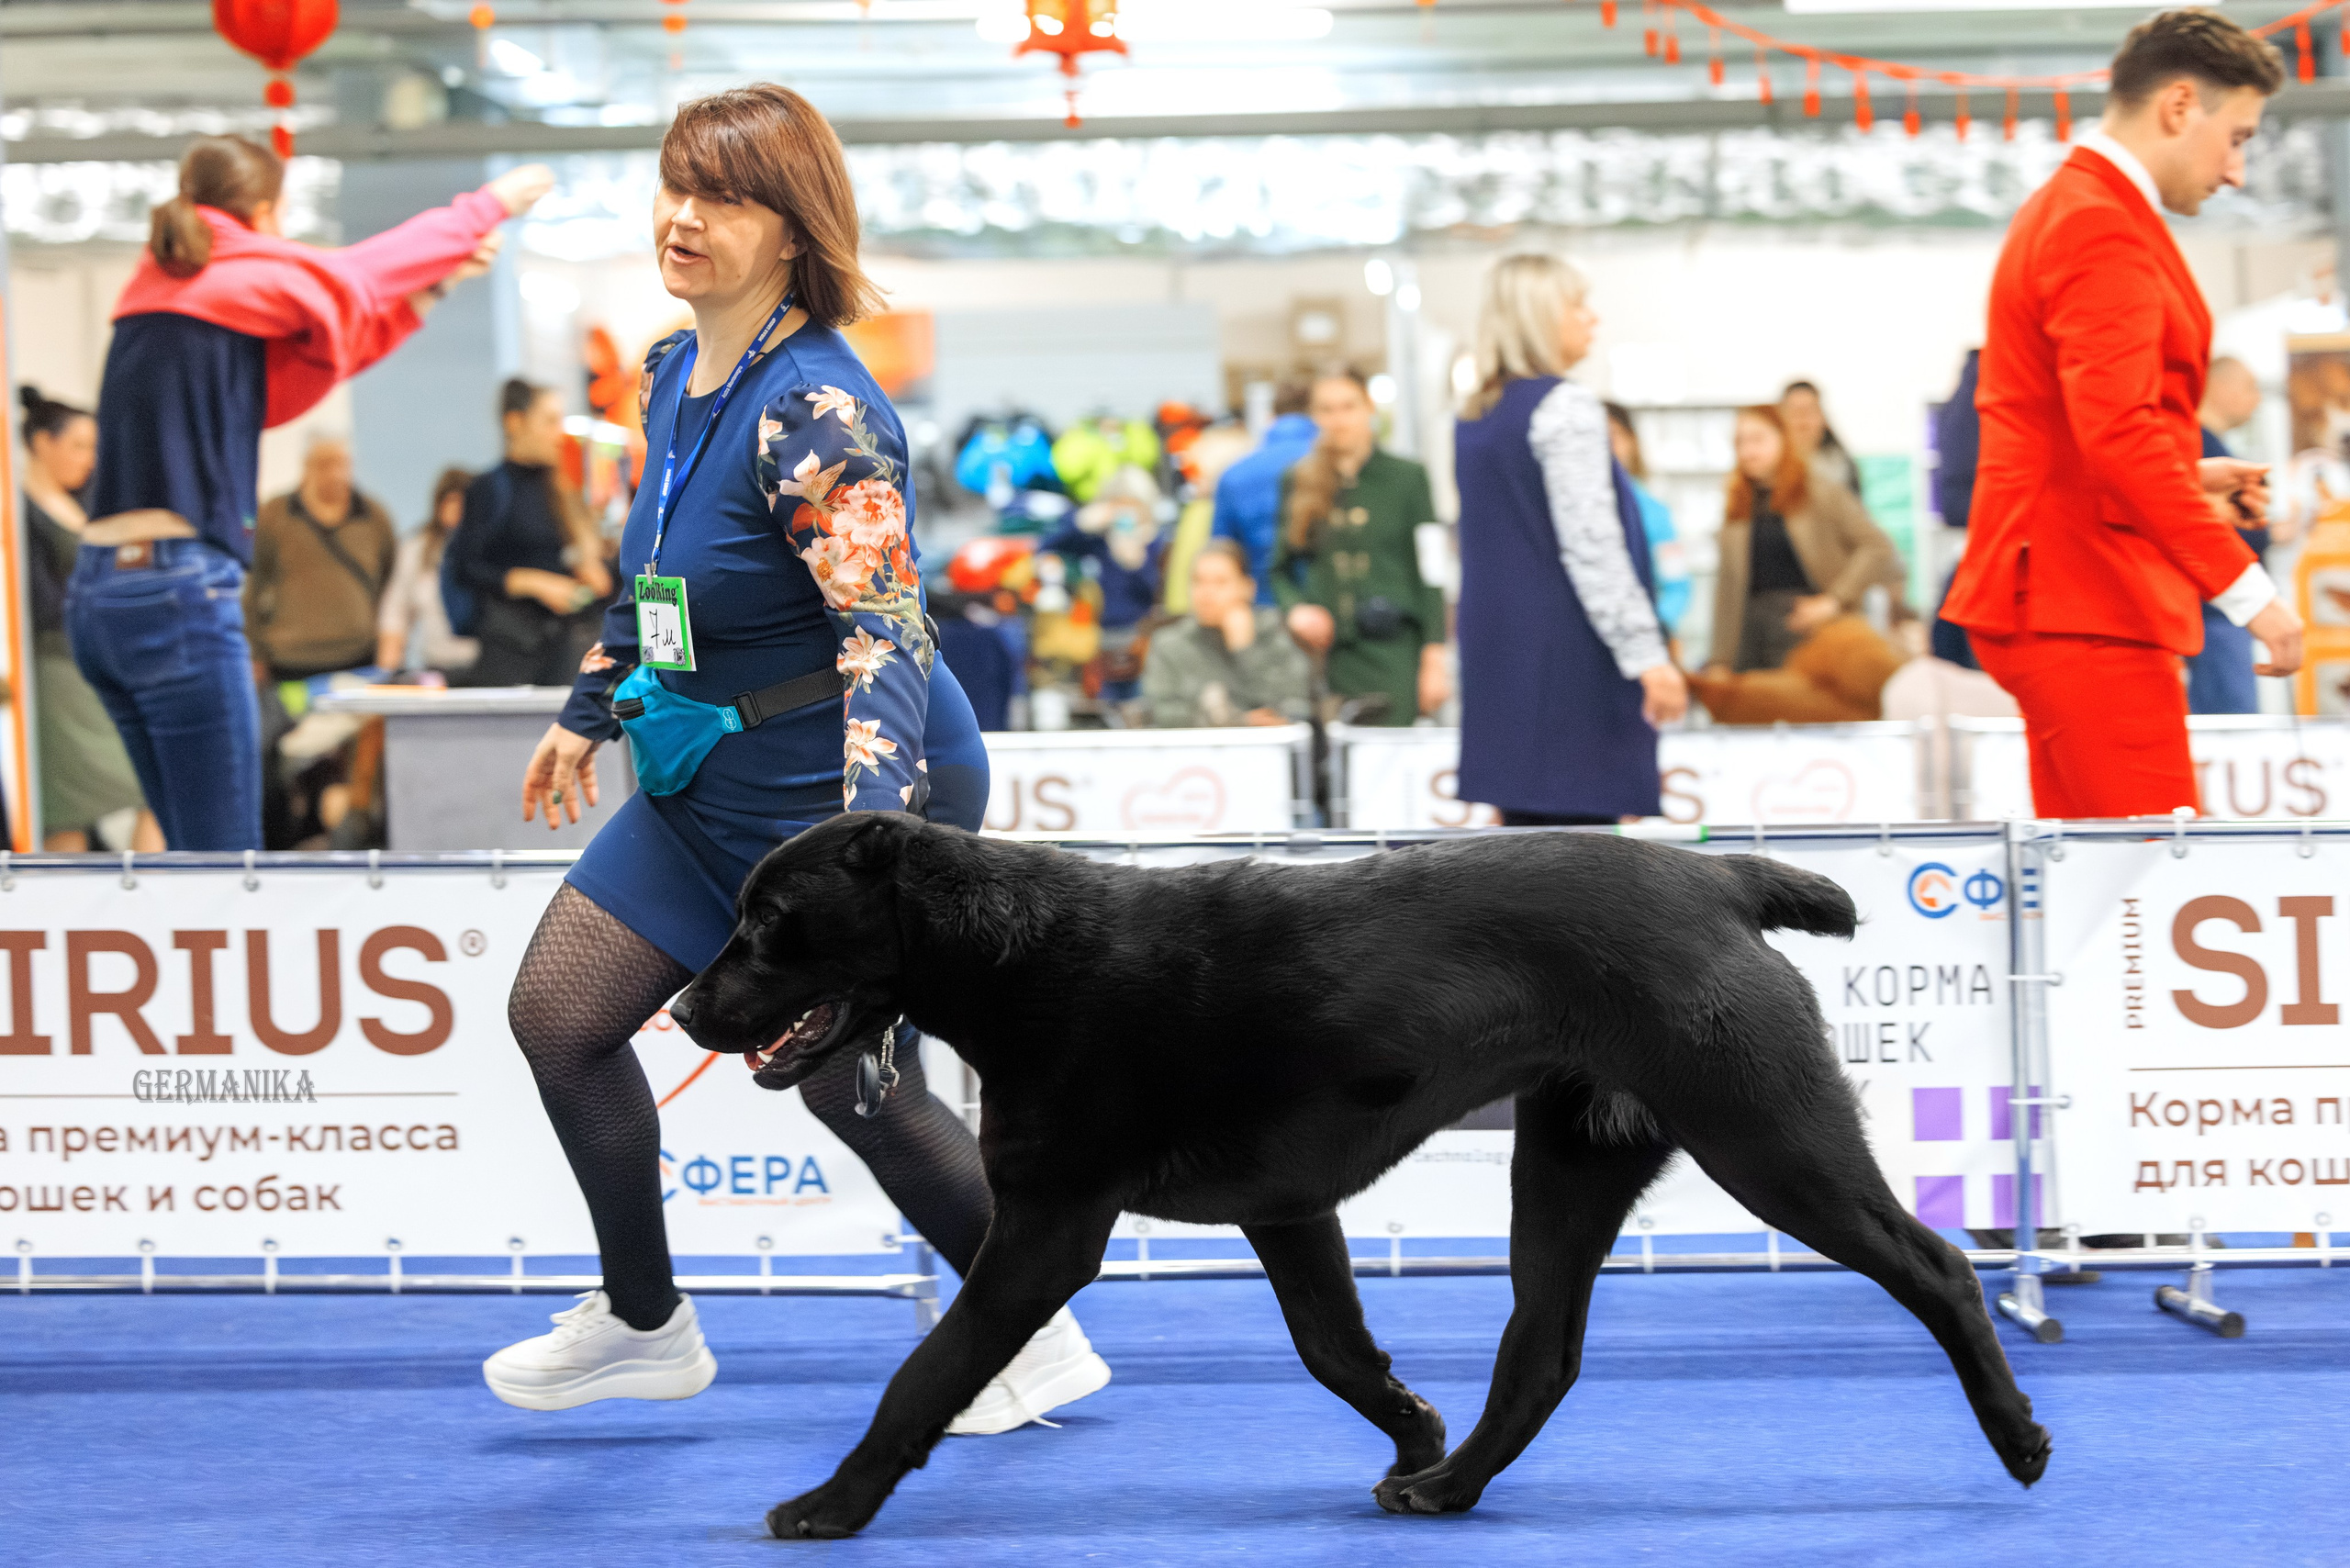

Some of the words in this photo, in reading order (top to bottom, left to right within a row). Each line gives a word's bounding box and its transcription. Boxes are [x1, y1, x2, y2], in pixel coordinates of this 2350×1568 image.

[2122, 898, 2144, 1029] PREMIUM
[2170, 894, 2342, 1030] SI
[0, 924, 454, 1056] IRIUS
[1843, 963, 1994, 1007] КОРМА
[1826, 1022, 1933, 1064] ШЕК
[2130, 1092, 2295, 1136] Корма
[2315, 1096, 2350, 1131] п
[29, 1123, 459, 1161] премиум-класса
[148, 1185, 174, 1212] и
[194, 1174, 342, 1213] собак
[2134, 1159, 2226, 1193] для
